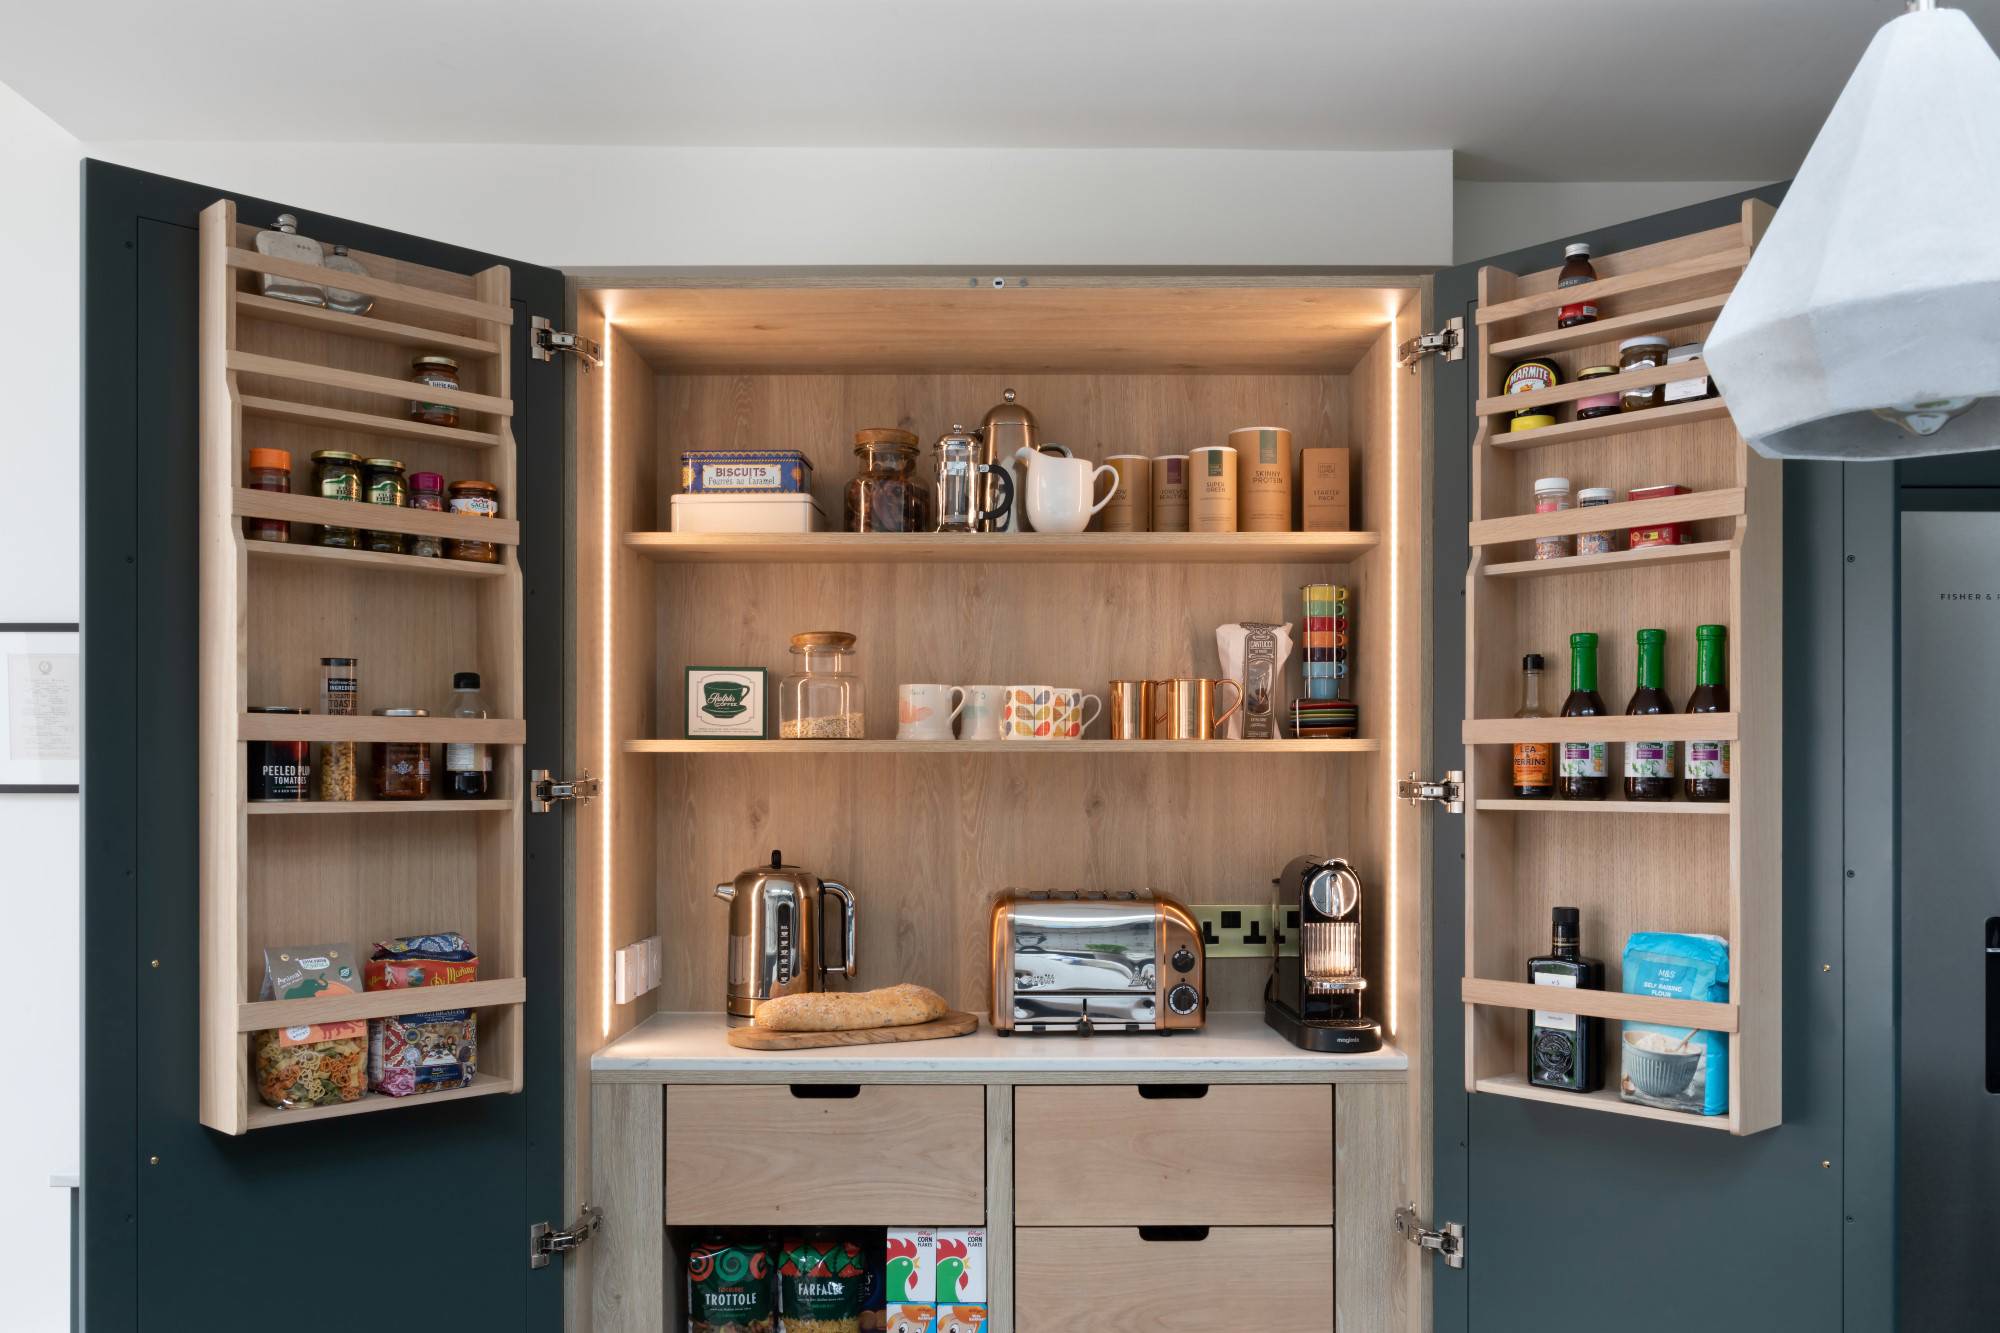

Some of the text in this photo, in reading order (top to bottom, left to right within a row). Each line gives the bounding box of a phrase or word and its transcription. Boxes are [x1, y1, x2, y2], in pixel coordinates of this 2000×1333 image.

[1509, 366, 1549, 384] MARMITE
[715, 467, 767, 477] BISCUITS
[748, 476, 775, 485] Caramel
[1940, 593, 1981, 601] FISHER
[1985, 593, 1992, 601] &
[1519, 745, 1536, 753] LEA
[1513, 758, 1546, 766] PERRINS
[262, 765, 296, 776] PEELED
[273, 776, 307, 785] TOMATOES
[1657, 969, 1676, 978] M&S
[1643, 981, 1683, 993] SELF RAISING
[1651, 989, 1672, 998] FLOUR
[705, 1292, 757, 1306] TROTTOLE
